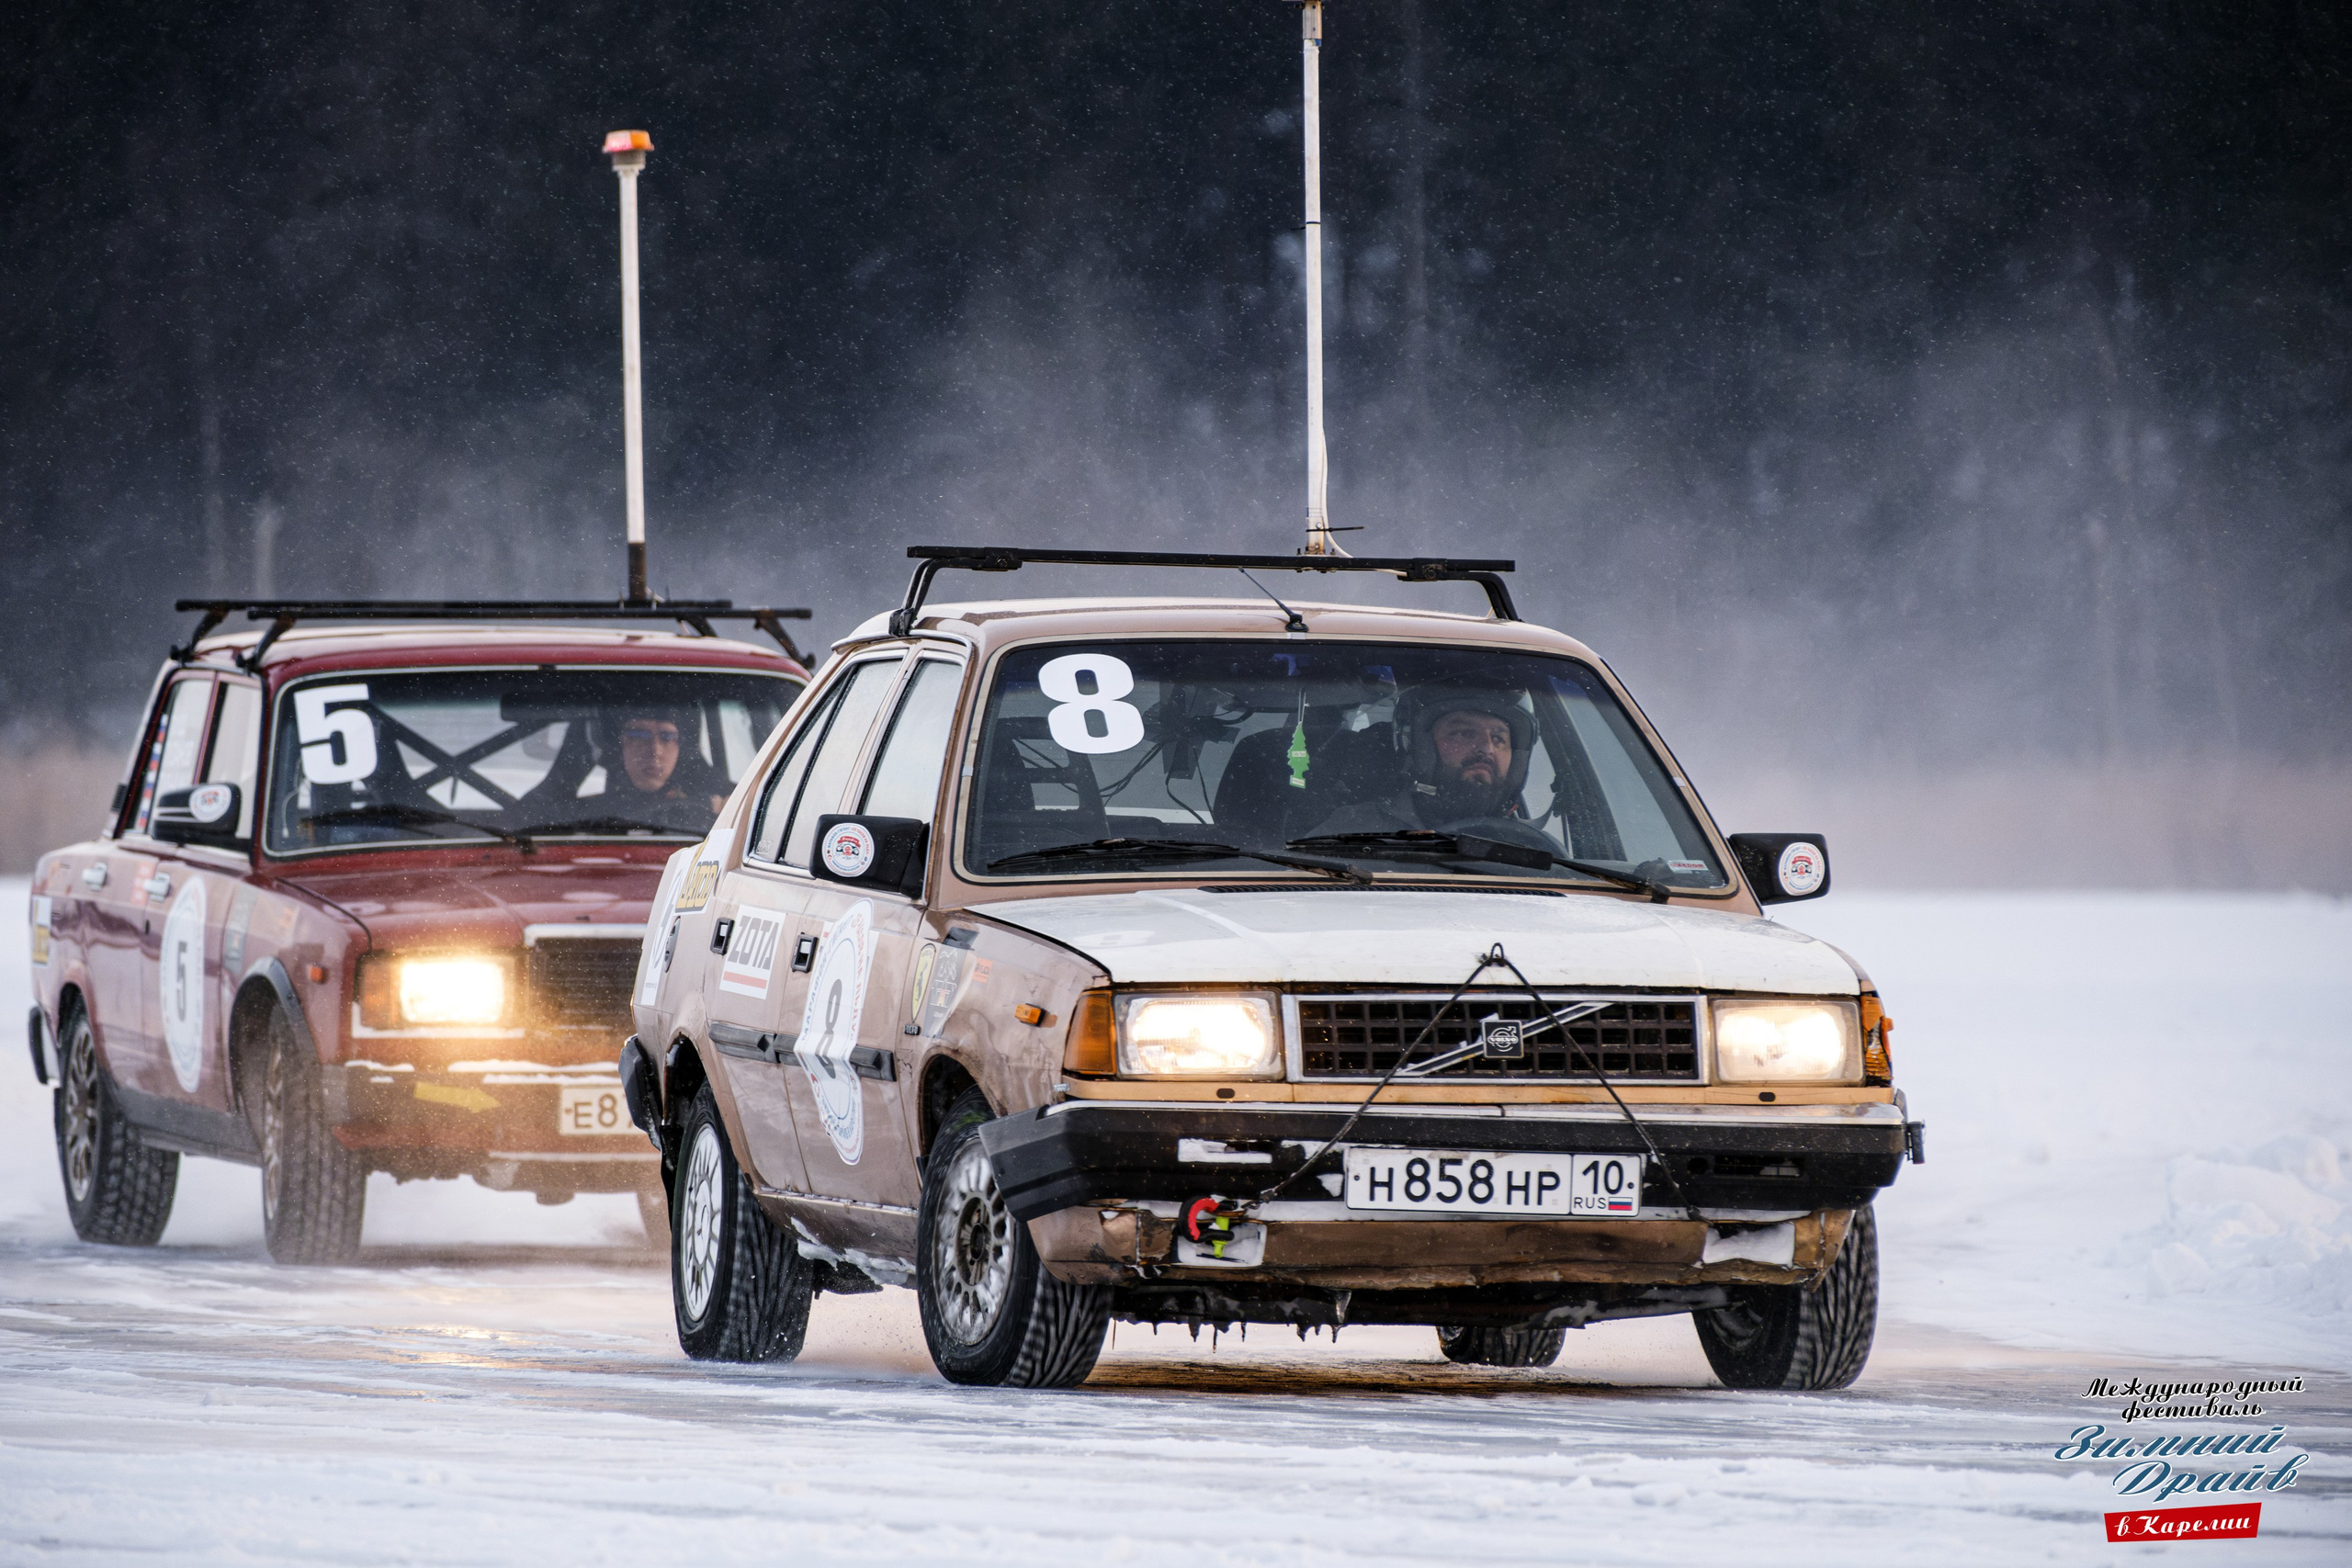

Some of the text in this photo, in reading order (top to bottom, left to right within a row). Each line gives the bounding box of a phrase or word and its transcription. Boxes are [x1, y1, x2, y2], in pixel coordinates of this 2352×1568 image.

[294, 683, 378, 784] 5
[1038, 653, 1145, 754] 8
[727, 915, 780, 971] ZOTA
[815, 978, 842, 1079] 8
[1573, 1197, 1607, 1210] RUS
[1582, 1160, 1623, 1195] 10
